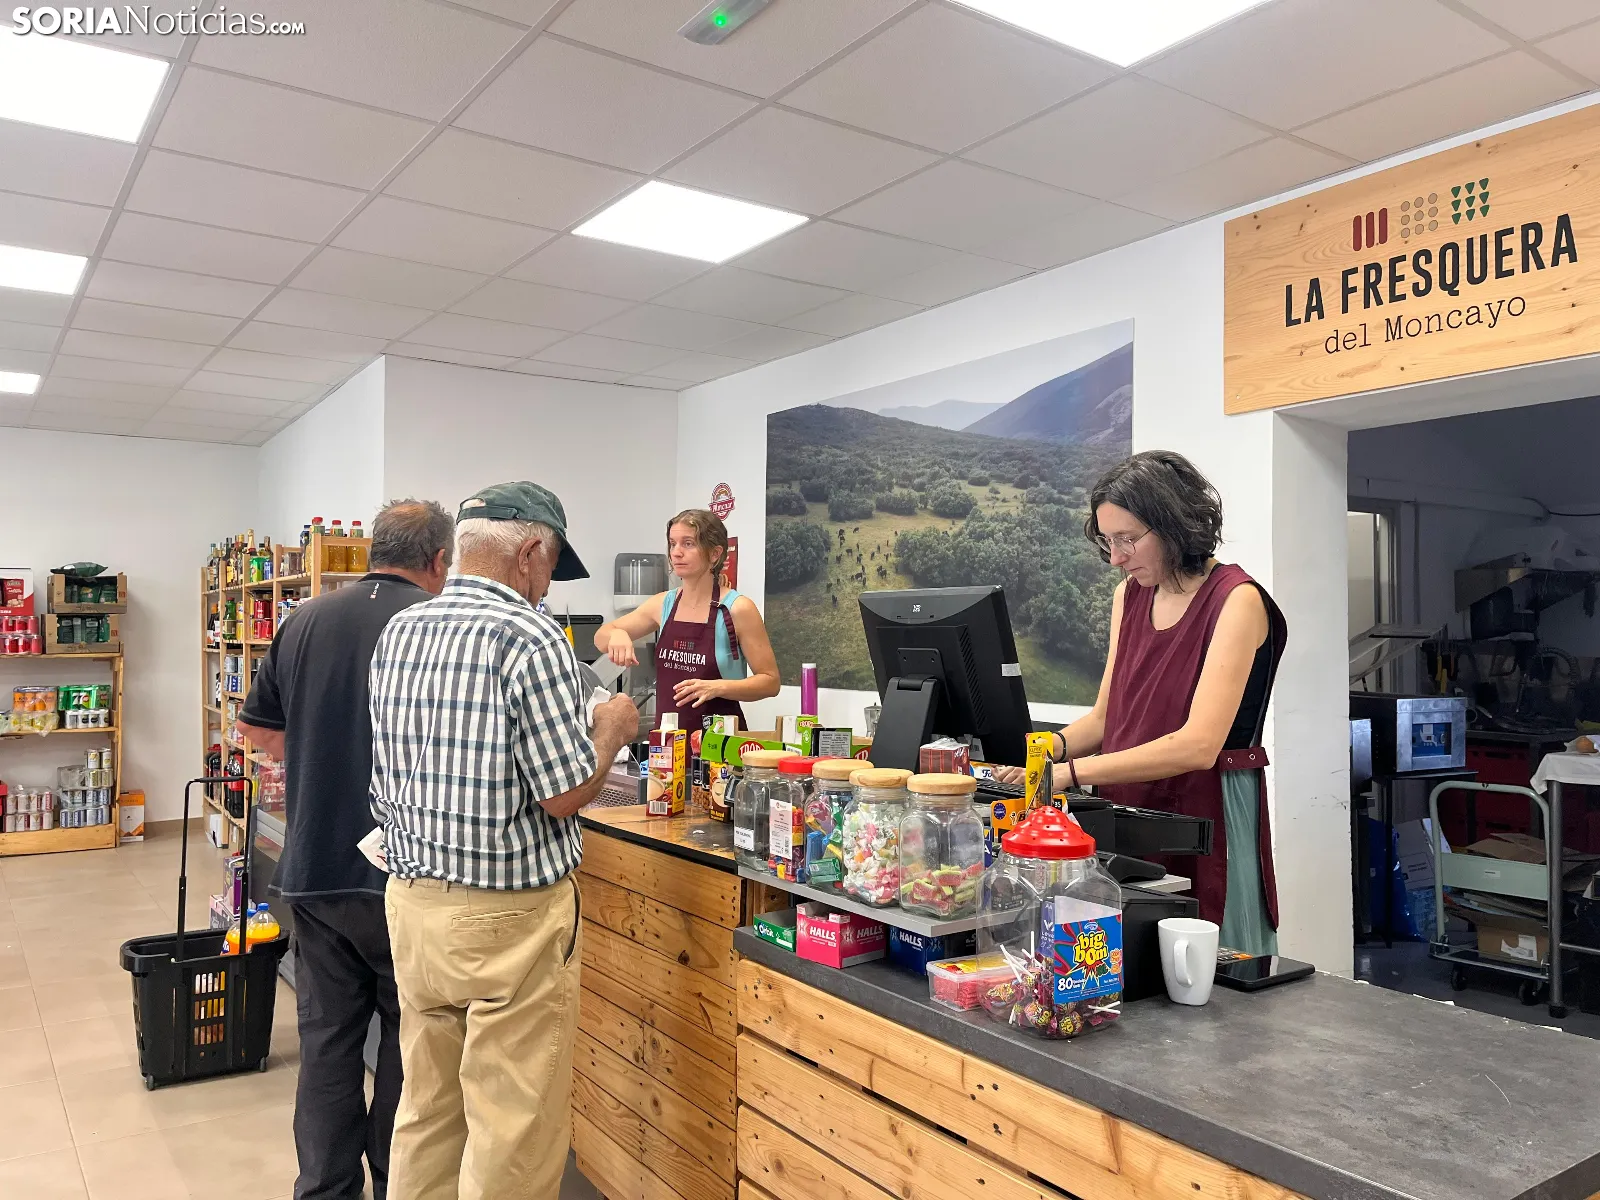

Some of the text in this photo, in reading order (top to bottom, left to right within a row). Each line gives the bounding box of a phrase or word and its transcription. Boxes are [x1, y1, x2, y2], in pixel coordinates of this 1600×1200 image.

[1285, 213, 1578, 328] LA FRESQUERA
[1324, 296, 1526, 354] del Moncayo
[659, 648, 706, 666] LA FRESQUERA
[809, 926, 836, 942] HALLS
[857, 925, 884, 939] HALLS
[899, 931, 923, 948] HALLS
[1077, 931, 1106, 951] big
[1073, 945, 1109, 966] bom
[1057, 976, 1074, 992] 80
